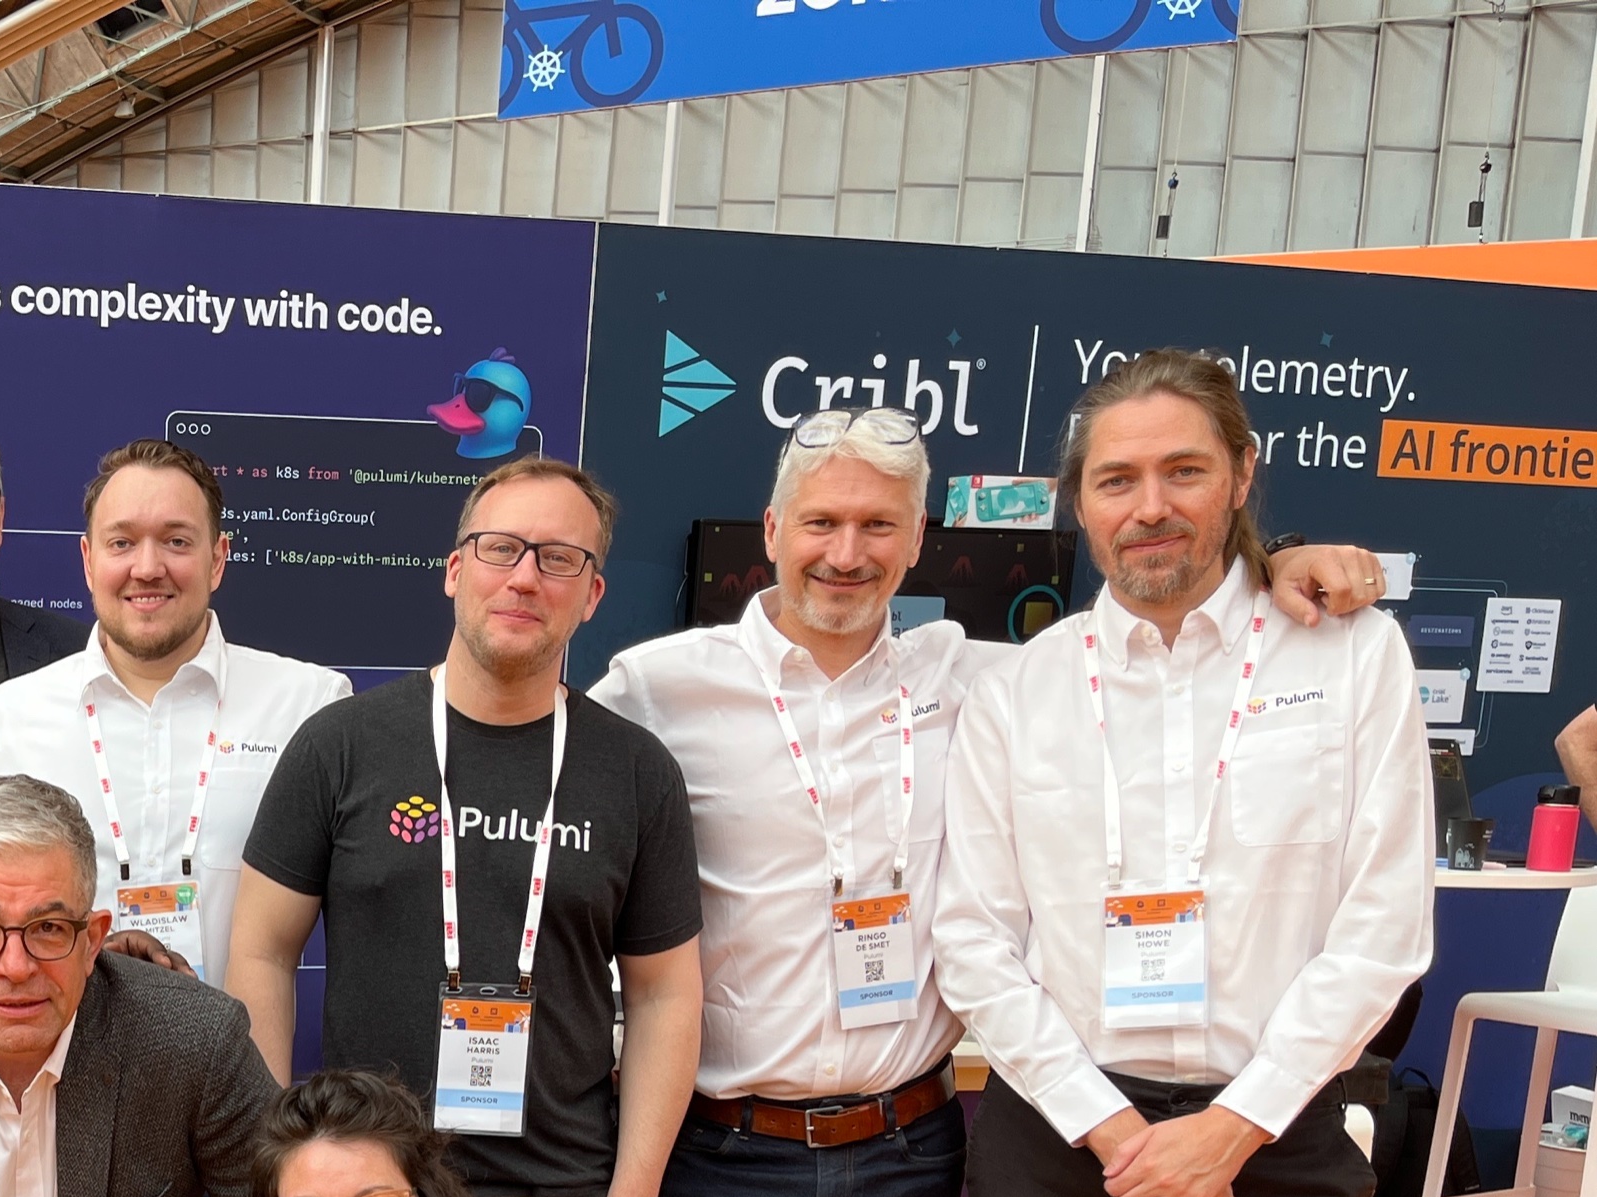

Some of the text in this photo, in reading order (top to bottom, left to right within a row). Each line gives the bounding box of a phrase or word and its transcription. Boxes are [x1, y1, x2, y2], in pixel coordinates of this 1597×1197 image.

[11, 281, 236, 334] complexity
[245, 287, 329, 330] with
[337, 297, 443, 336] code.
[1215, 345, 1415, 412] elemetry.
[1296, 421, 1366, 468] the
[1391, 429, 1435, 471] AI
[1450, 429, 1594, 480] frontie
[252, 469, 268, 478] as
[276, 467, 300, 479] k8s
[308, 468, 339, 480] from
[50, 598, 83, 609] nodes
[1275, 689, 1324, 707] Pulumi
[911, 700, 940, 717] ulumi
[241, 742, 277, 754] Pulumi
[458, 806, 592, 852] Pulumi
[130, 915, 188, 927] WLADISLAW
[146, 926, 175, 934] MITZEL
[1135, 929, 1172, 940] SIMON
[858, 931, 887, 943] RINGO
[856, 940, 891, 952] DE SMET
[1137, 940, 1170, 948] HOWE
[860, 990, 893, 1000] SPONSOR
[1132, 991, 1174, 999] SPONSOR
[468, 1036, 500, 1046] ISAAC
[466, 1047, 500, 1055] HARRIS
[460, 1095, 498, 1104] SPONSOR
